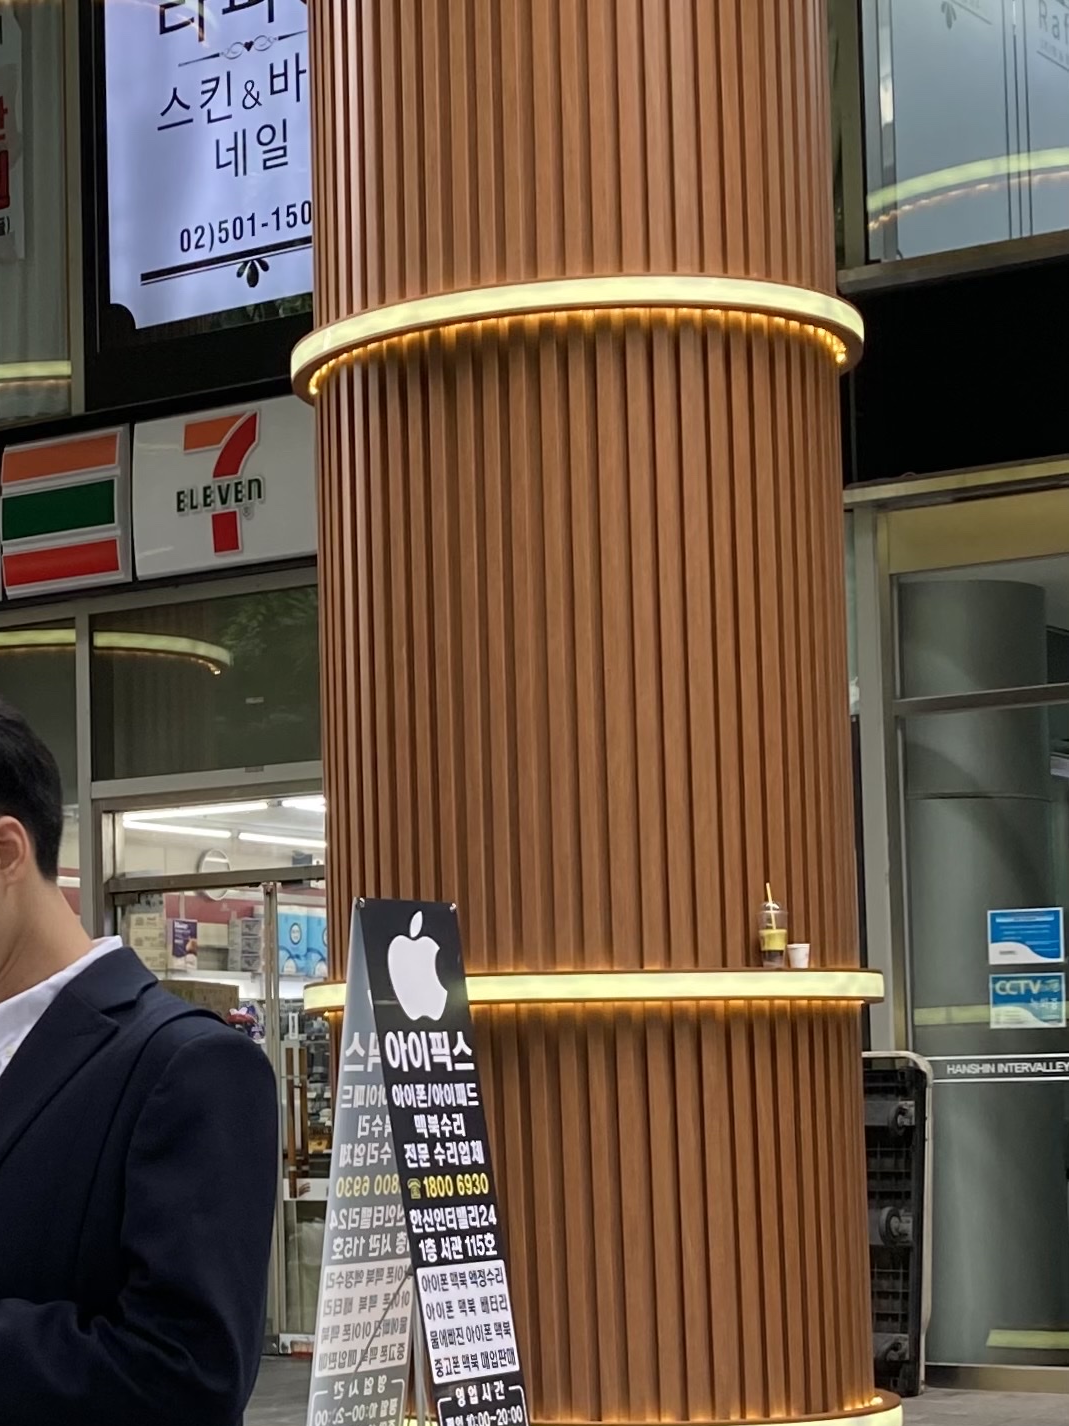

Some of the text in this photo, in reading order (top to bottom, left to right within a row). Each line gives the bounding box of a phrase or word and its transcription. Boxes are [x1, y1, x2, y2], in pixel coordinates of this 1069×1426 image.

[215, 118, 289, 177] 네일
[184, 412, 258, 554] 7
[995, 979, 1042, 996] CCTV
[385, 1031, 475, 1072] 아이픽스
[947, 1063, 996, 1075] HANSHIN
[391, 1083, 480, 1108] 아이폰/아이패드
[413, 1113, 467, 1139] 맥북수리
[404, 1140, 486, 1168] 전문 수리업체
[423, 1172, 489, 1198] 1800 6930
[419, 1232, 498, 1263] 1층 서관 115호
[421, 1273, 449, 1294] 아이폰
[425, 1300, 455, 1321] 아이폰
[466, 1323, 493, 1344] 아이폰
[434, 1356, 461, 1378] 중고폰
[480, 1347, 517, 1370] 매입판매
